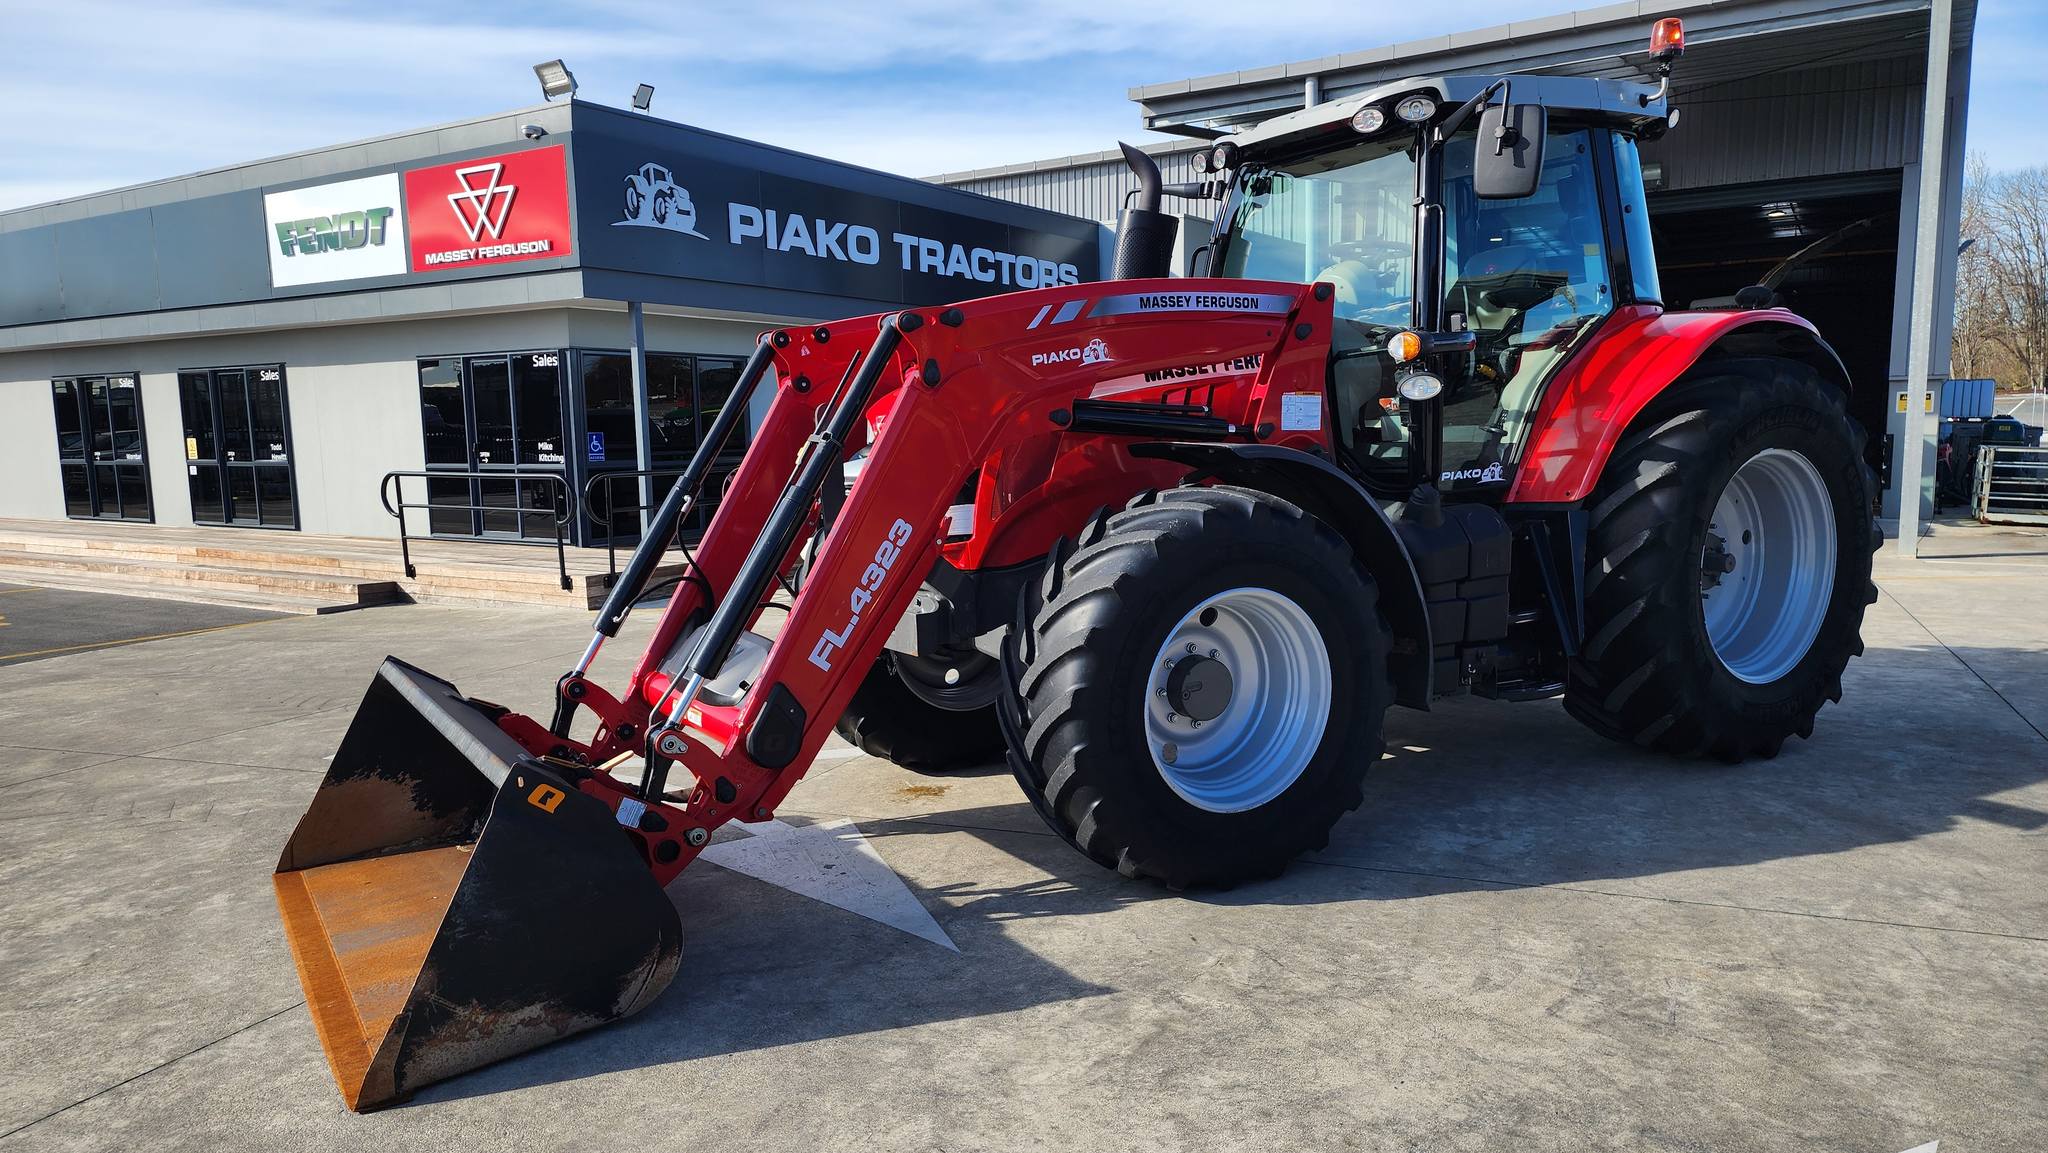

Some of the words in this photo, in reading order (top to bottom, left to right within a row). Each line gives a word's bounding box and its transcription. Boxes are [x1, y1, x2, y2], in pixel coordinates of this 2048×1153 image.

[274, 206, 394, 257] FENDT
[727, 201, 880, 266] PIAKO
[893, 232, 1079, 290] TRACTORS
[425, 247, 476, 266] MASSEY
[477, 240, 551, 259] FERGUSON
[1139, 296, 1192, 310] MASSEY
[1195, 295, 1259, 310] FERGUSON
[532, 354, 558, 368] Sales
[1032, 346, 1081, 367] PIAKO
[119, 378, 134, 388] Sales
[260, 370, 279, 382] Sales
[538, 442, 553, 451] Mike
[539, 453, 564, 464] Kitching
[1441, 468, 1481, 481] PIAKO
[808, 518, 913, 672] FL.4323
